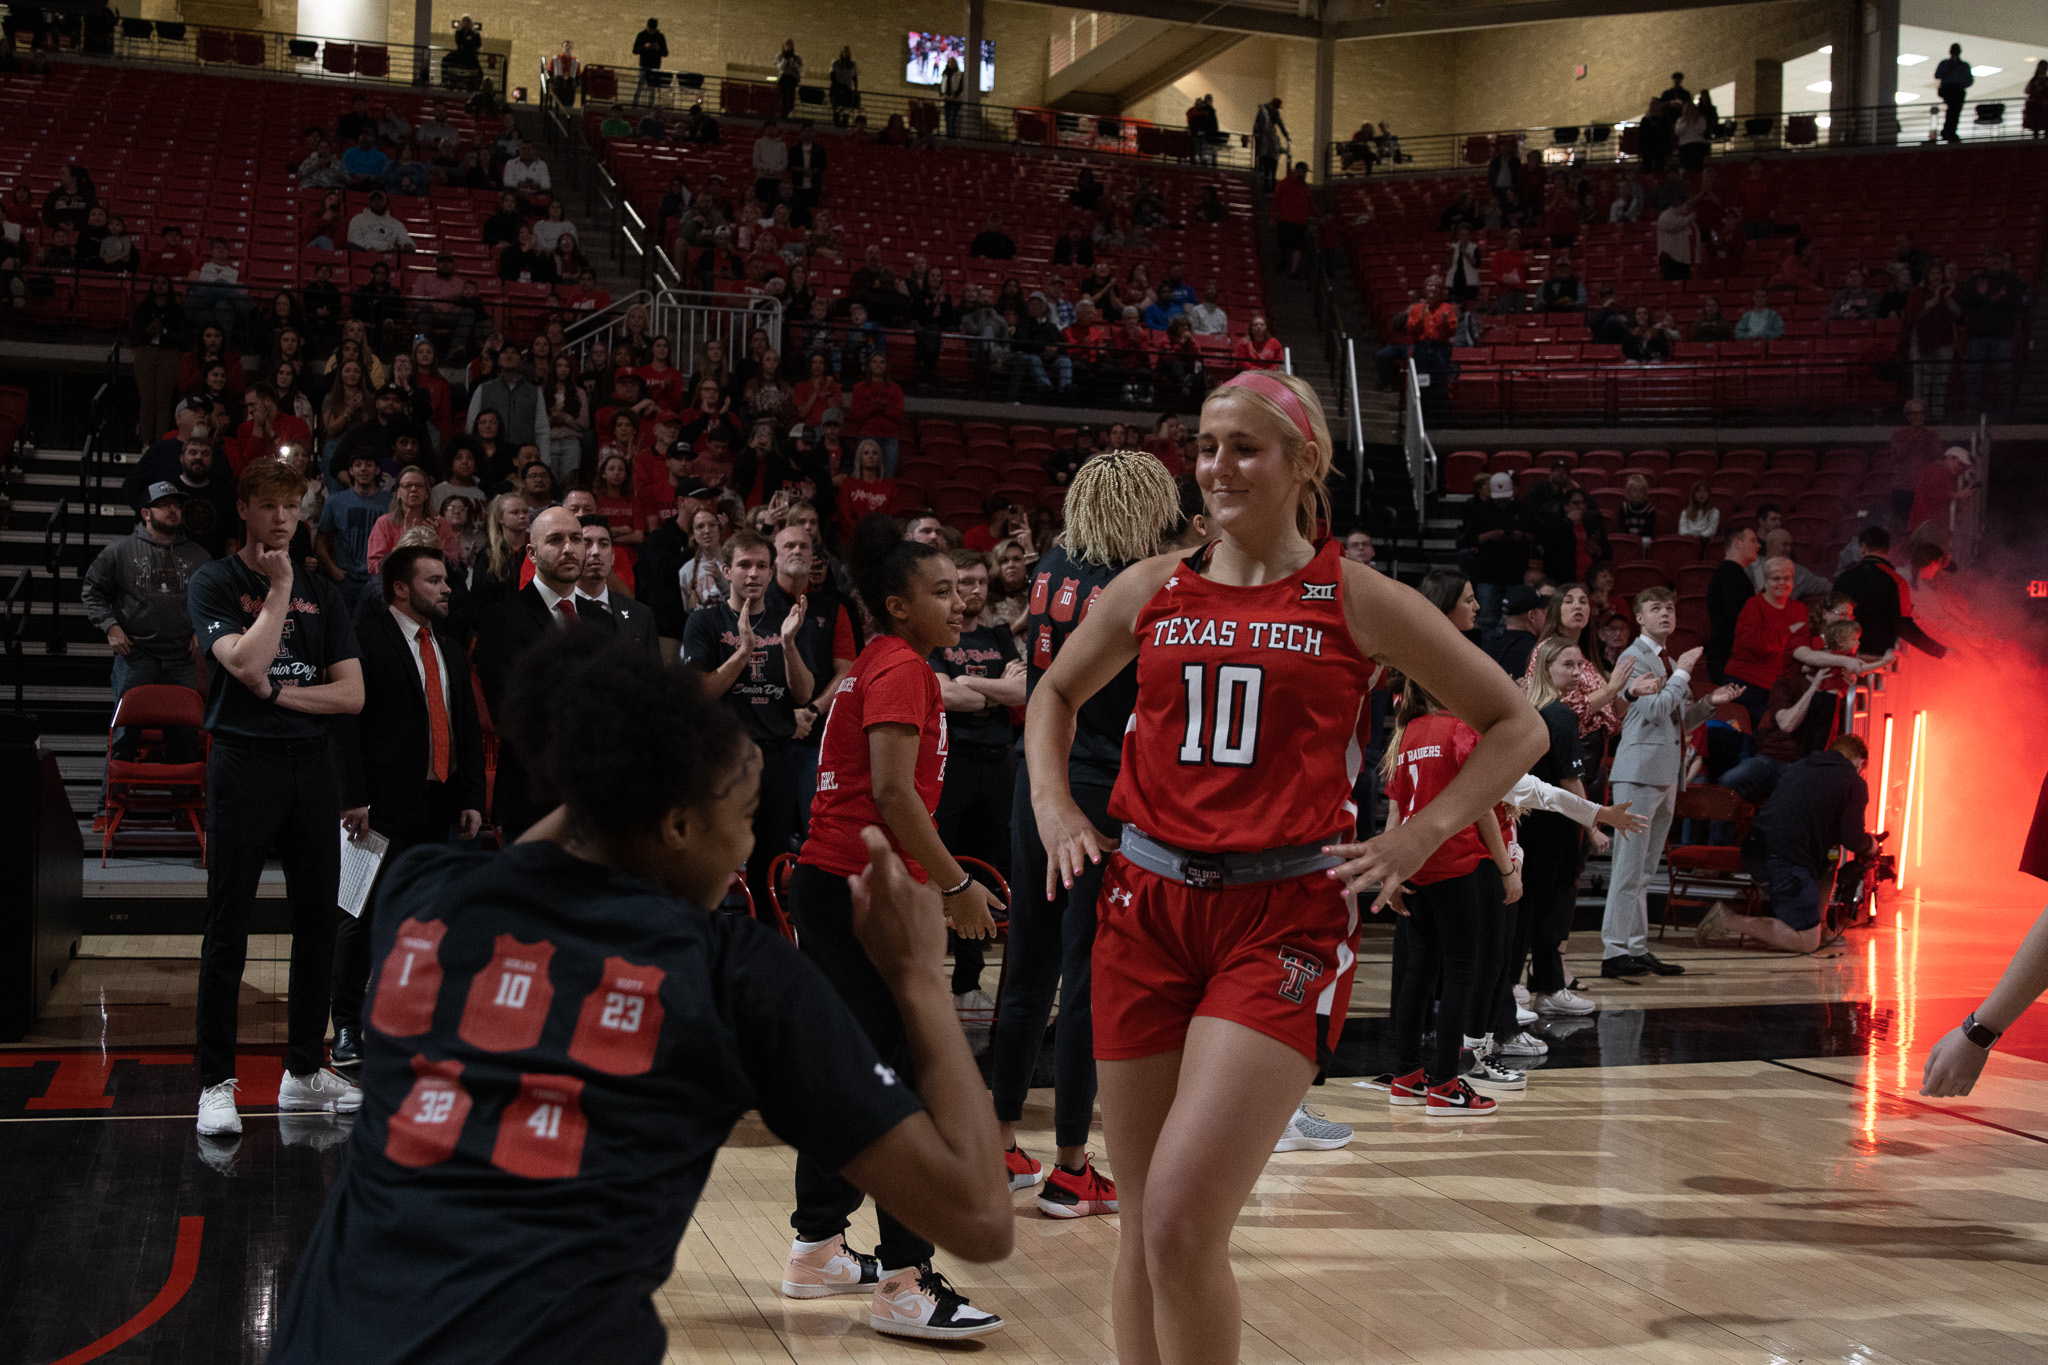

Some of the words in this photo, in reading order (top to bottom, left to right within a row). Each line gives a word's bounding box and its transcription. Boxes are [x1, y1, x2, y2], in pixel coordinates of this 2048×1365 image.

[1060, 591, 1073, 606] 10
[1301, 582, 1337, 601] XII
[1153, 617, 1238, 647] TEXAS
[1248, 621, 1323, 656] TECH
[290, 662, 317, 681] Day
[731, 683, 763, 695] Senior
[764, 684, 786, 700] Day
[1178, 662, 1266, 768] 10
[399, 953, 415, 988] 1
[494, 972, 532, 1010] 10
[600, 991, 646, 1033] 23
[413, 1090, 456, 1124] 32
[525, 1103, 563, 1140] 41
